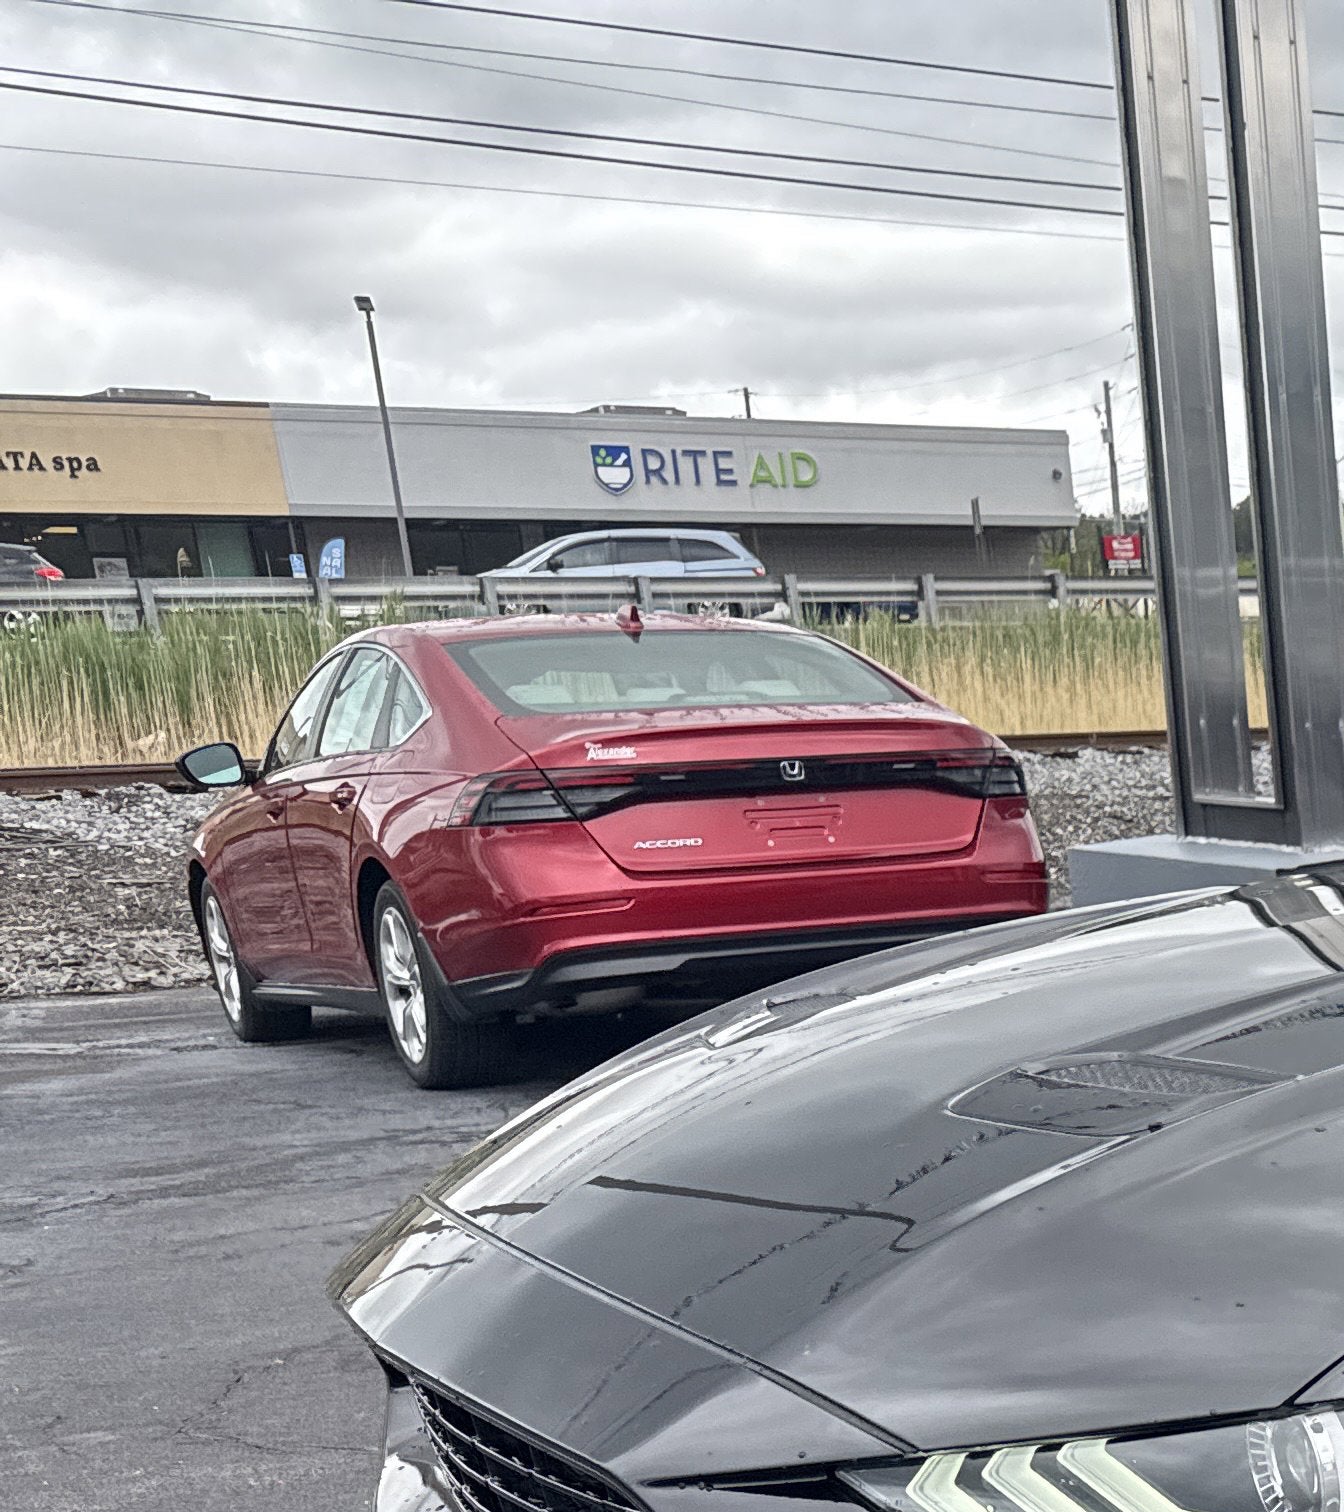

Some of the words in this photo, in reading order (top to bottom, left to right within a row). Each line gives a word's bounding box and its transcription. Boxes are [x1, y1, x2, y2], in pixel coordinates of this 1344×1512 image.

[51, 456, 102, 479] spa
[640, 448, 738, 487] RITE
[749, 451, 819, 489] AID
[633, 837, 703, 849] ACCORD
